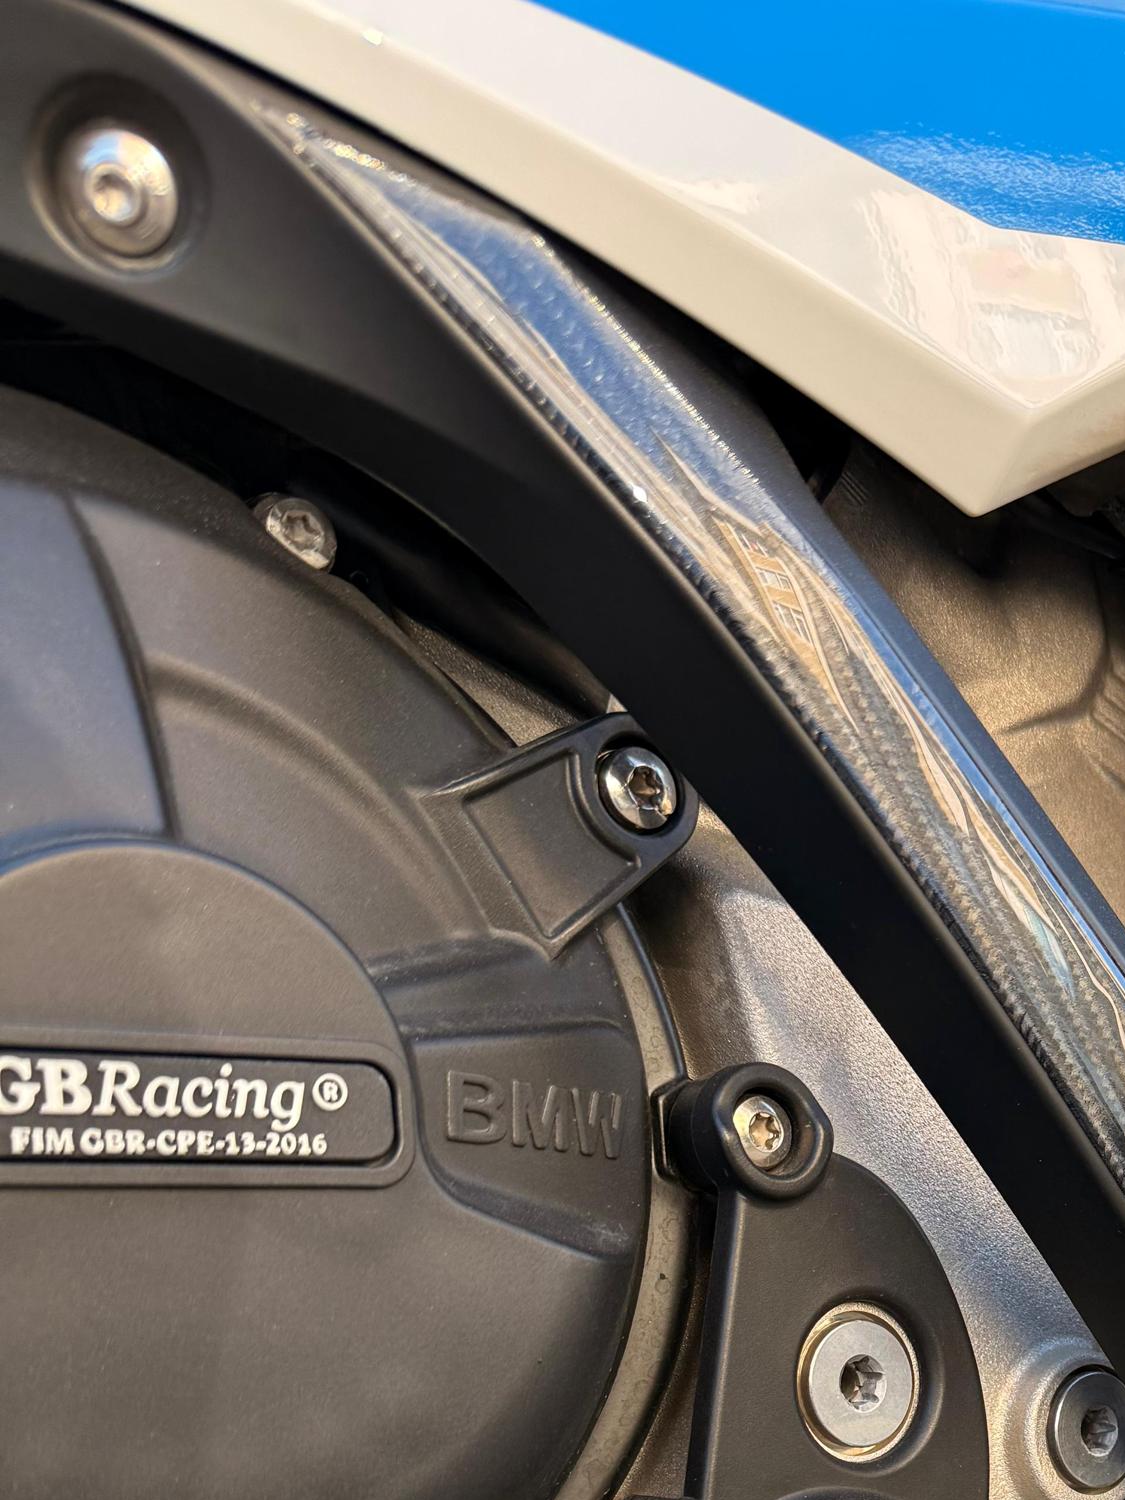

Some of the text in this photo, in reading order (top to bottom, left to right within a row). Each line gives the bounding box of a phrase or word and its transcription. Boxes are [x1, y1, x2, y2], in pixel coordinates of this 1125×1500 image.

[10, 1126, 329, 1156] FIM GBR-CPE-13-2016
[446, 1070, 623, 1160] BMW
